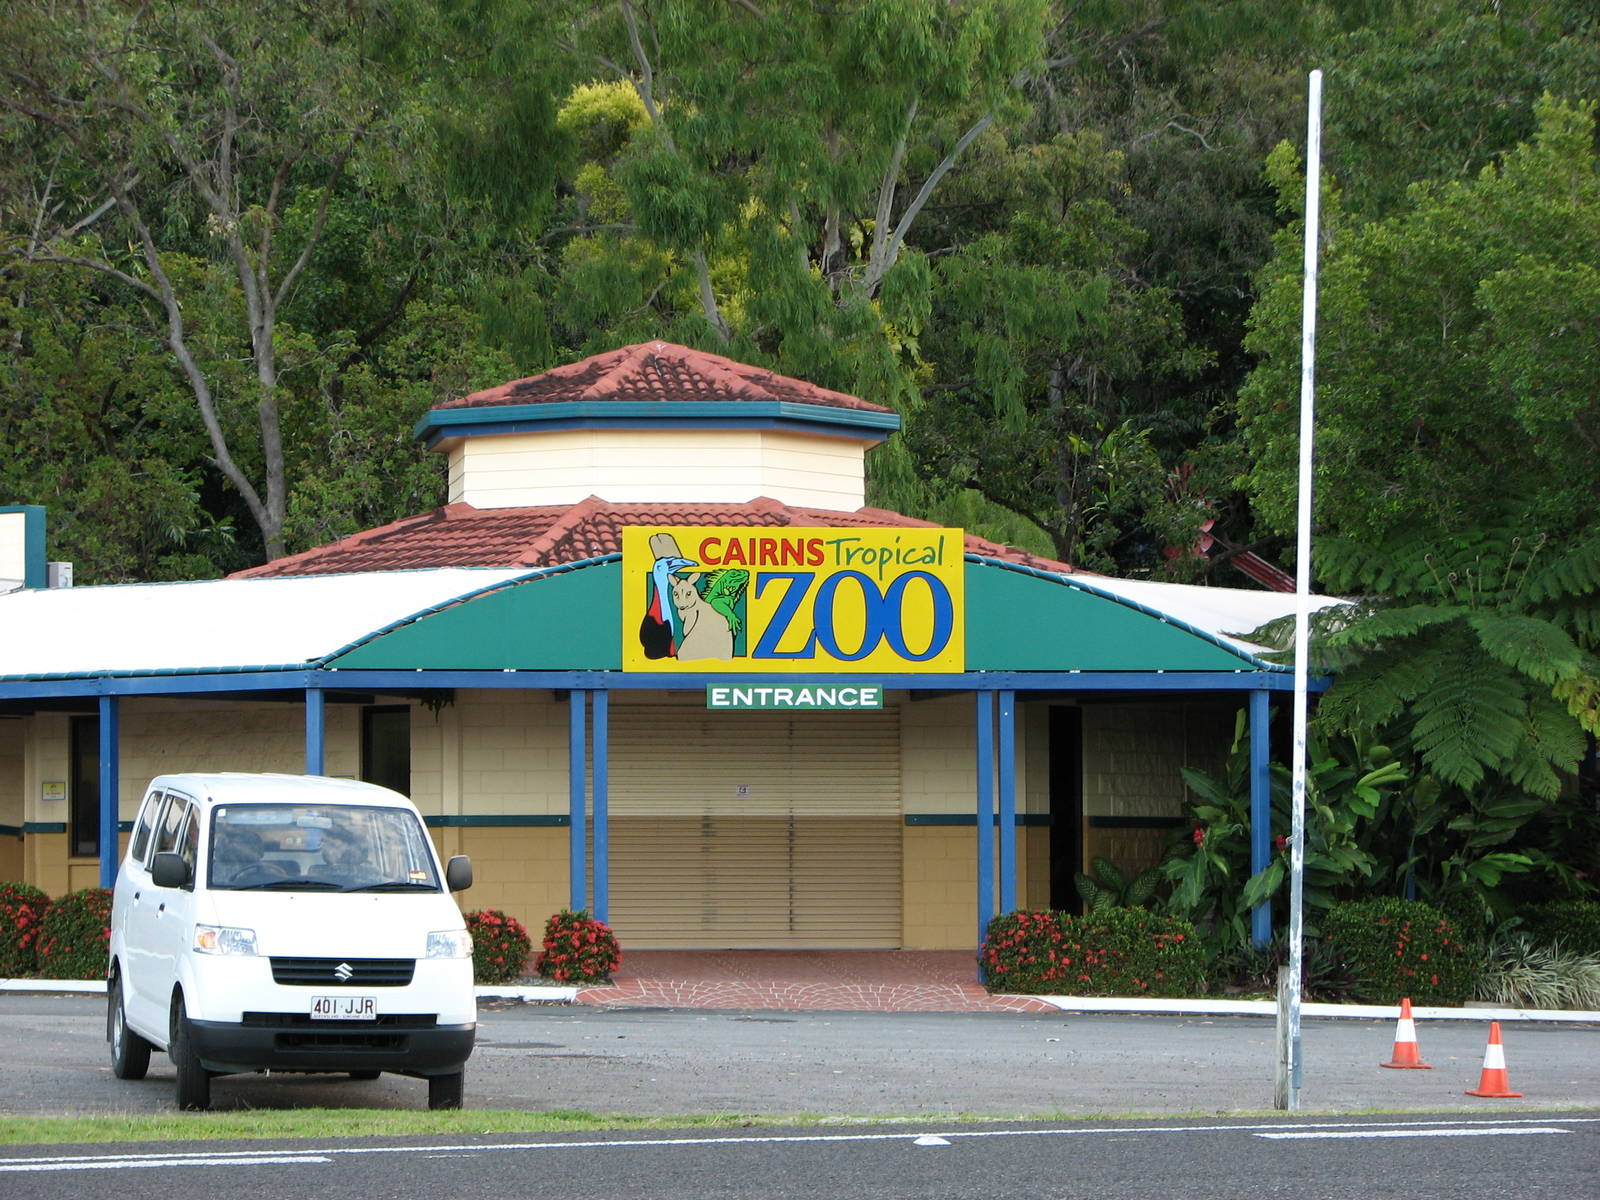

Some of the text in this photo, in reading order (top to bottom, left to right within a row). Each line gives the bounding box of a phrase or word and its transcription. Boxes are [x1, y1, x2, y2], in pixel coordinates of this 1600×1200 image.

[699, 535, 945, 580] CAIRNS Tropical
[751, 570, 954, 662] ZOO
[711, 687, 878, 706] ENTRANCE
[314, 999, 374, 1014] 401 JJR
